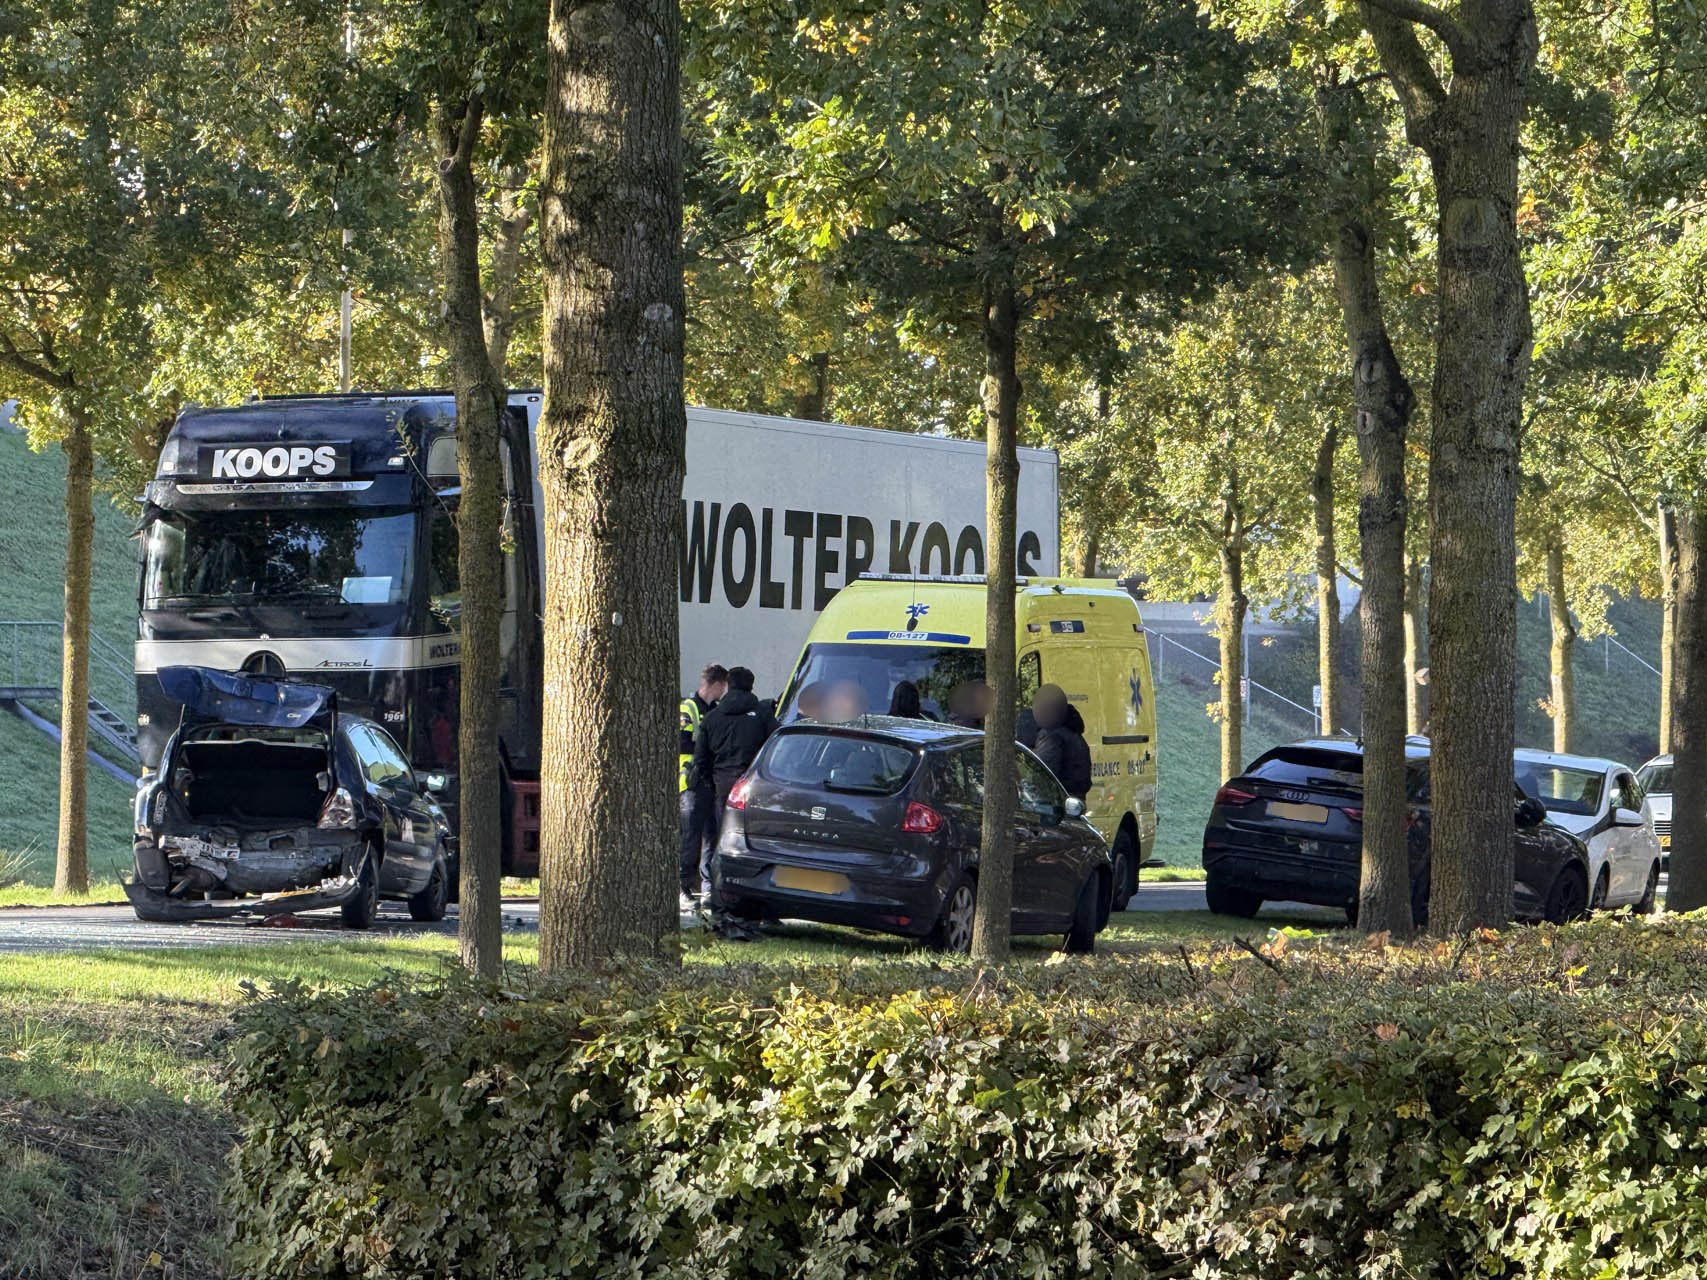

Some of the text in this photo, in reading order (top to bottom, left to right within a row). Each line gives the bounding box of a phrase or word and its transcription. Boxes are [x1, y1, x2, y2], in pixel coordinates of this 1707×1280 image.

[212, 446, 336, 478] KOOPS
[679, 499, 1041, 612] WOLTER KOOS
[889, 631, 926, 639] 08-127
[1092, 762, 1120, 777] BULANCE
[793, 828, 839, 839] ALTEA
